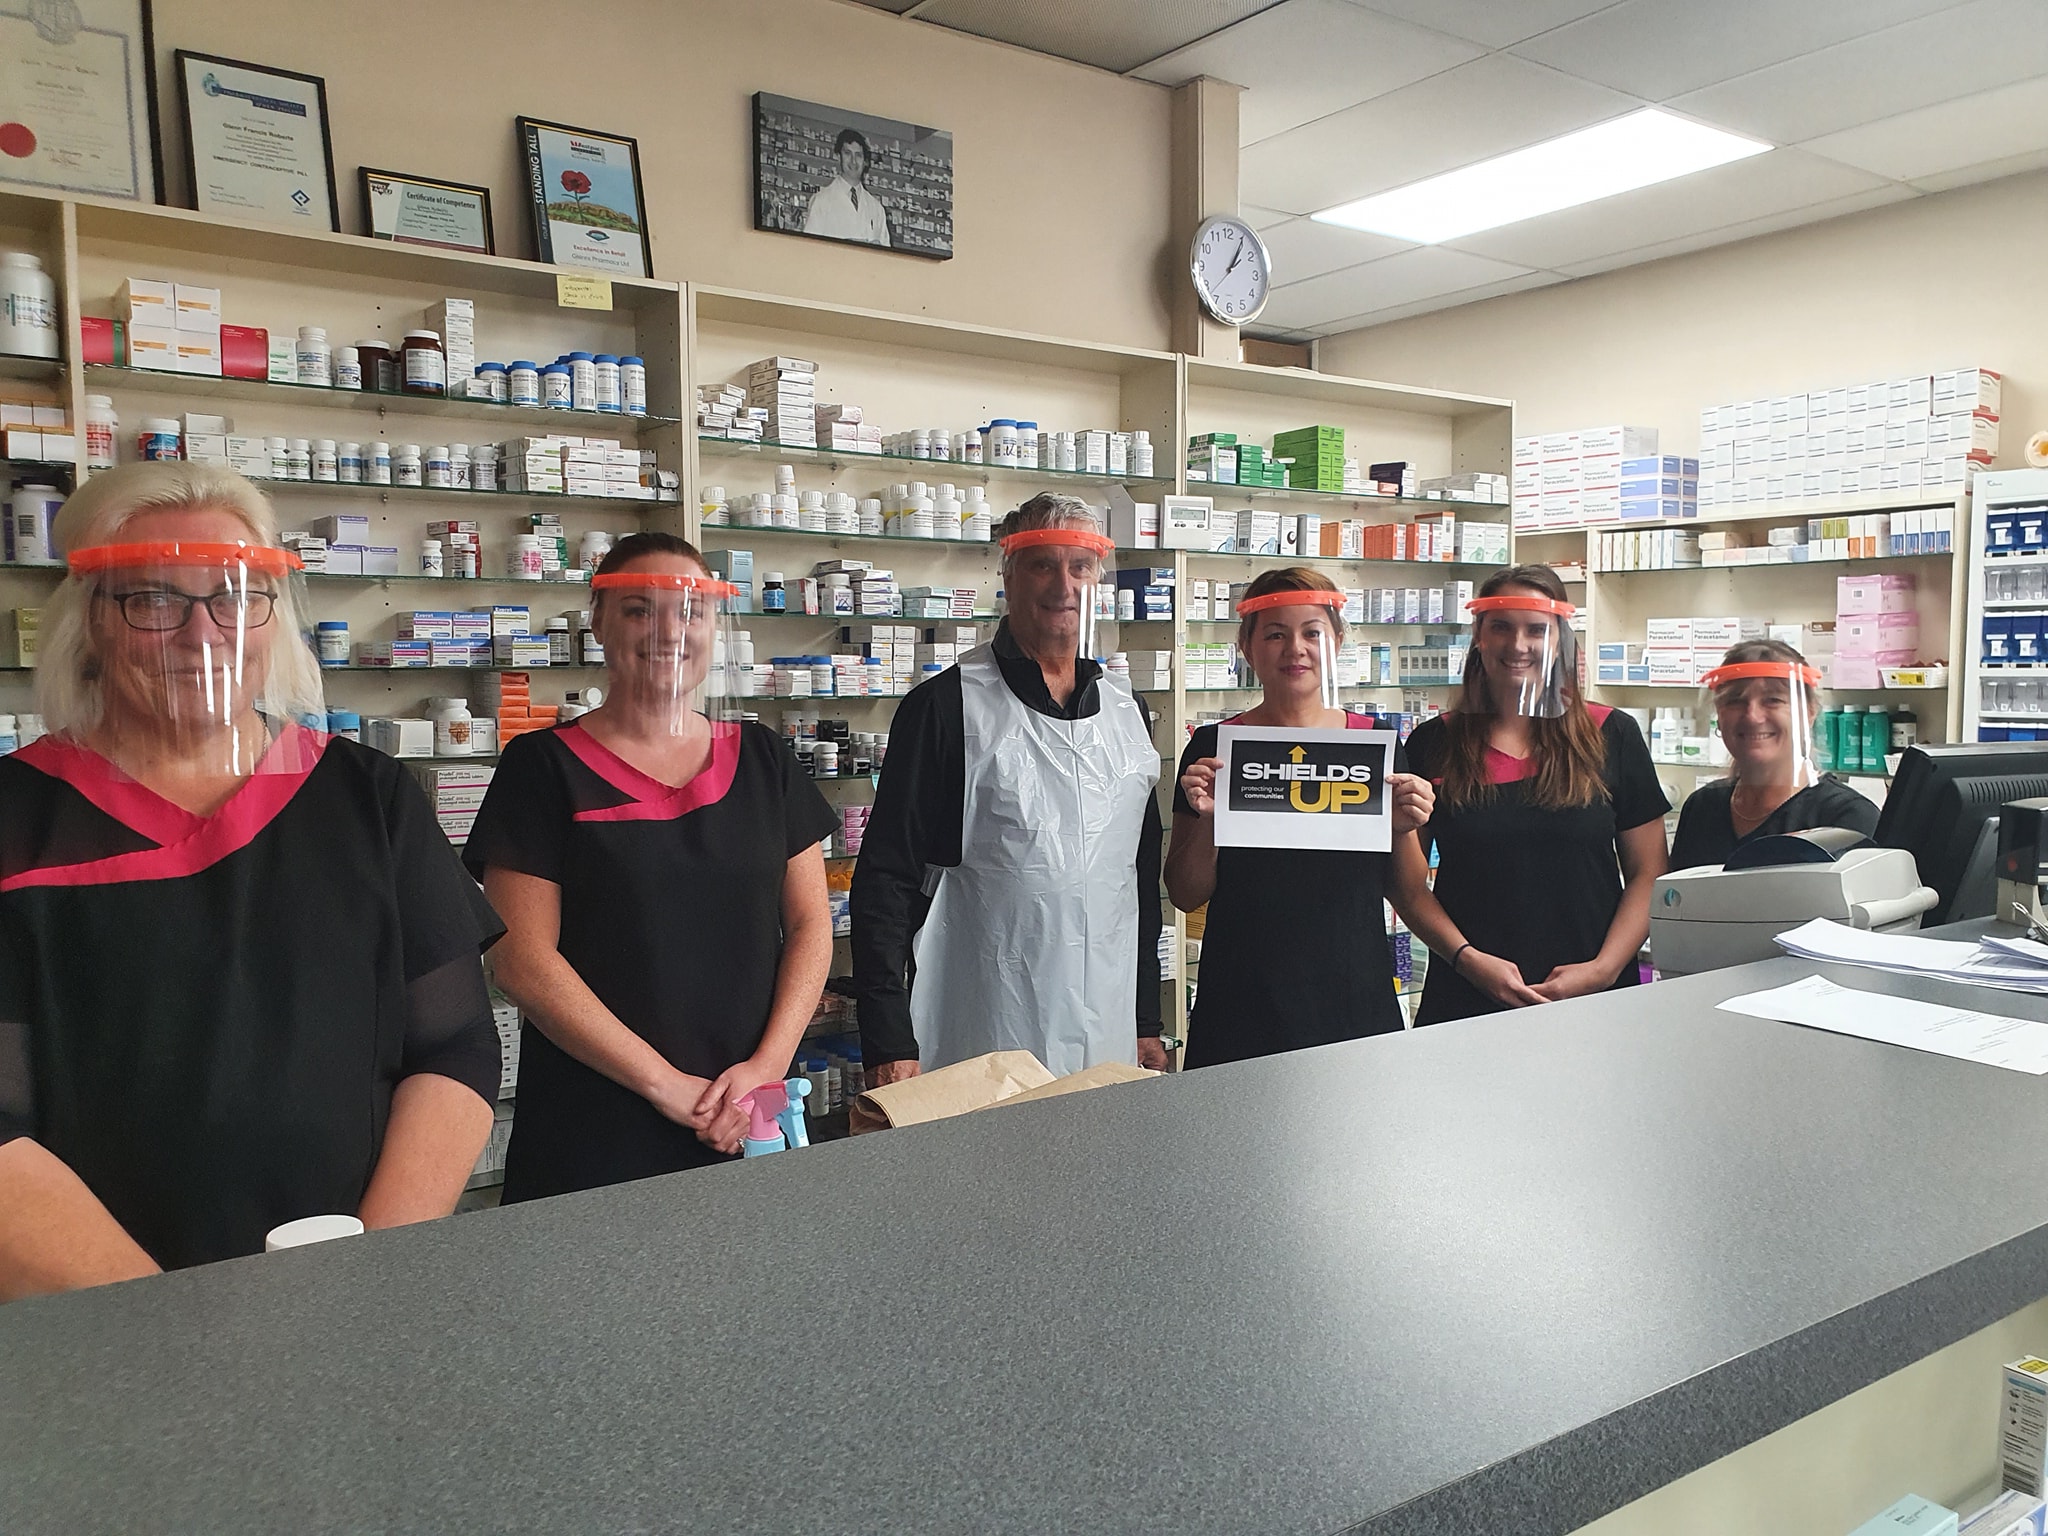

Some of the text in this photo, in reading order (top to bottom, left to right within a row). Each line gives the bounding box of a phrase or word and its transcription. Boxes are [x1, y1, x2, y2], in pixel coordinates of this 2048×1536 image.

[244, 126, 268, 136] Francis
[268, 131, 294, 141] Roberts
[250, 162, 294, 174] CONTRACEPTIVE
[528, 134, 544, 204] STANDING TALL
[406, 192, 436, 203] Certificate
[442, 198, 476, 209] Competence
[1210, 231, 1220, 242] 11
[1222, 228, 1234, 240] 12
[574, 244, 604, 254] Excellence
[1202, 243, 1212, 254] 10
[592, 256, 619, 266] Pharmacy
[1248, 251, 1254, 262] 2
[1252, 270, 1259, 281] 3
[1249, 288, 1255, 298] 4
[1214, 295, 1220, 304] 7
[1240, 300, 1246, 310] 5
[1226, 302, 1233, 314] 6
[1242, 762, 1372, 783] SHIELDS
[1290, 780, 1370, 813] UP
